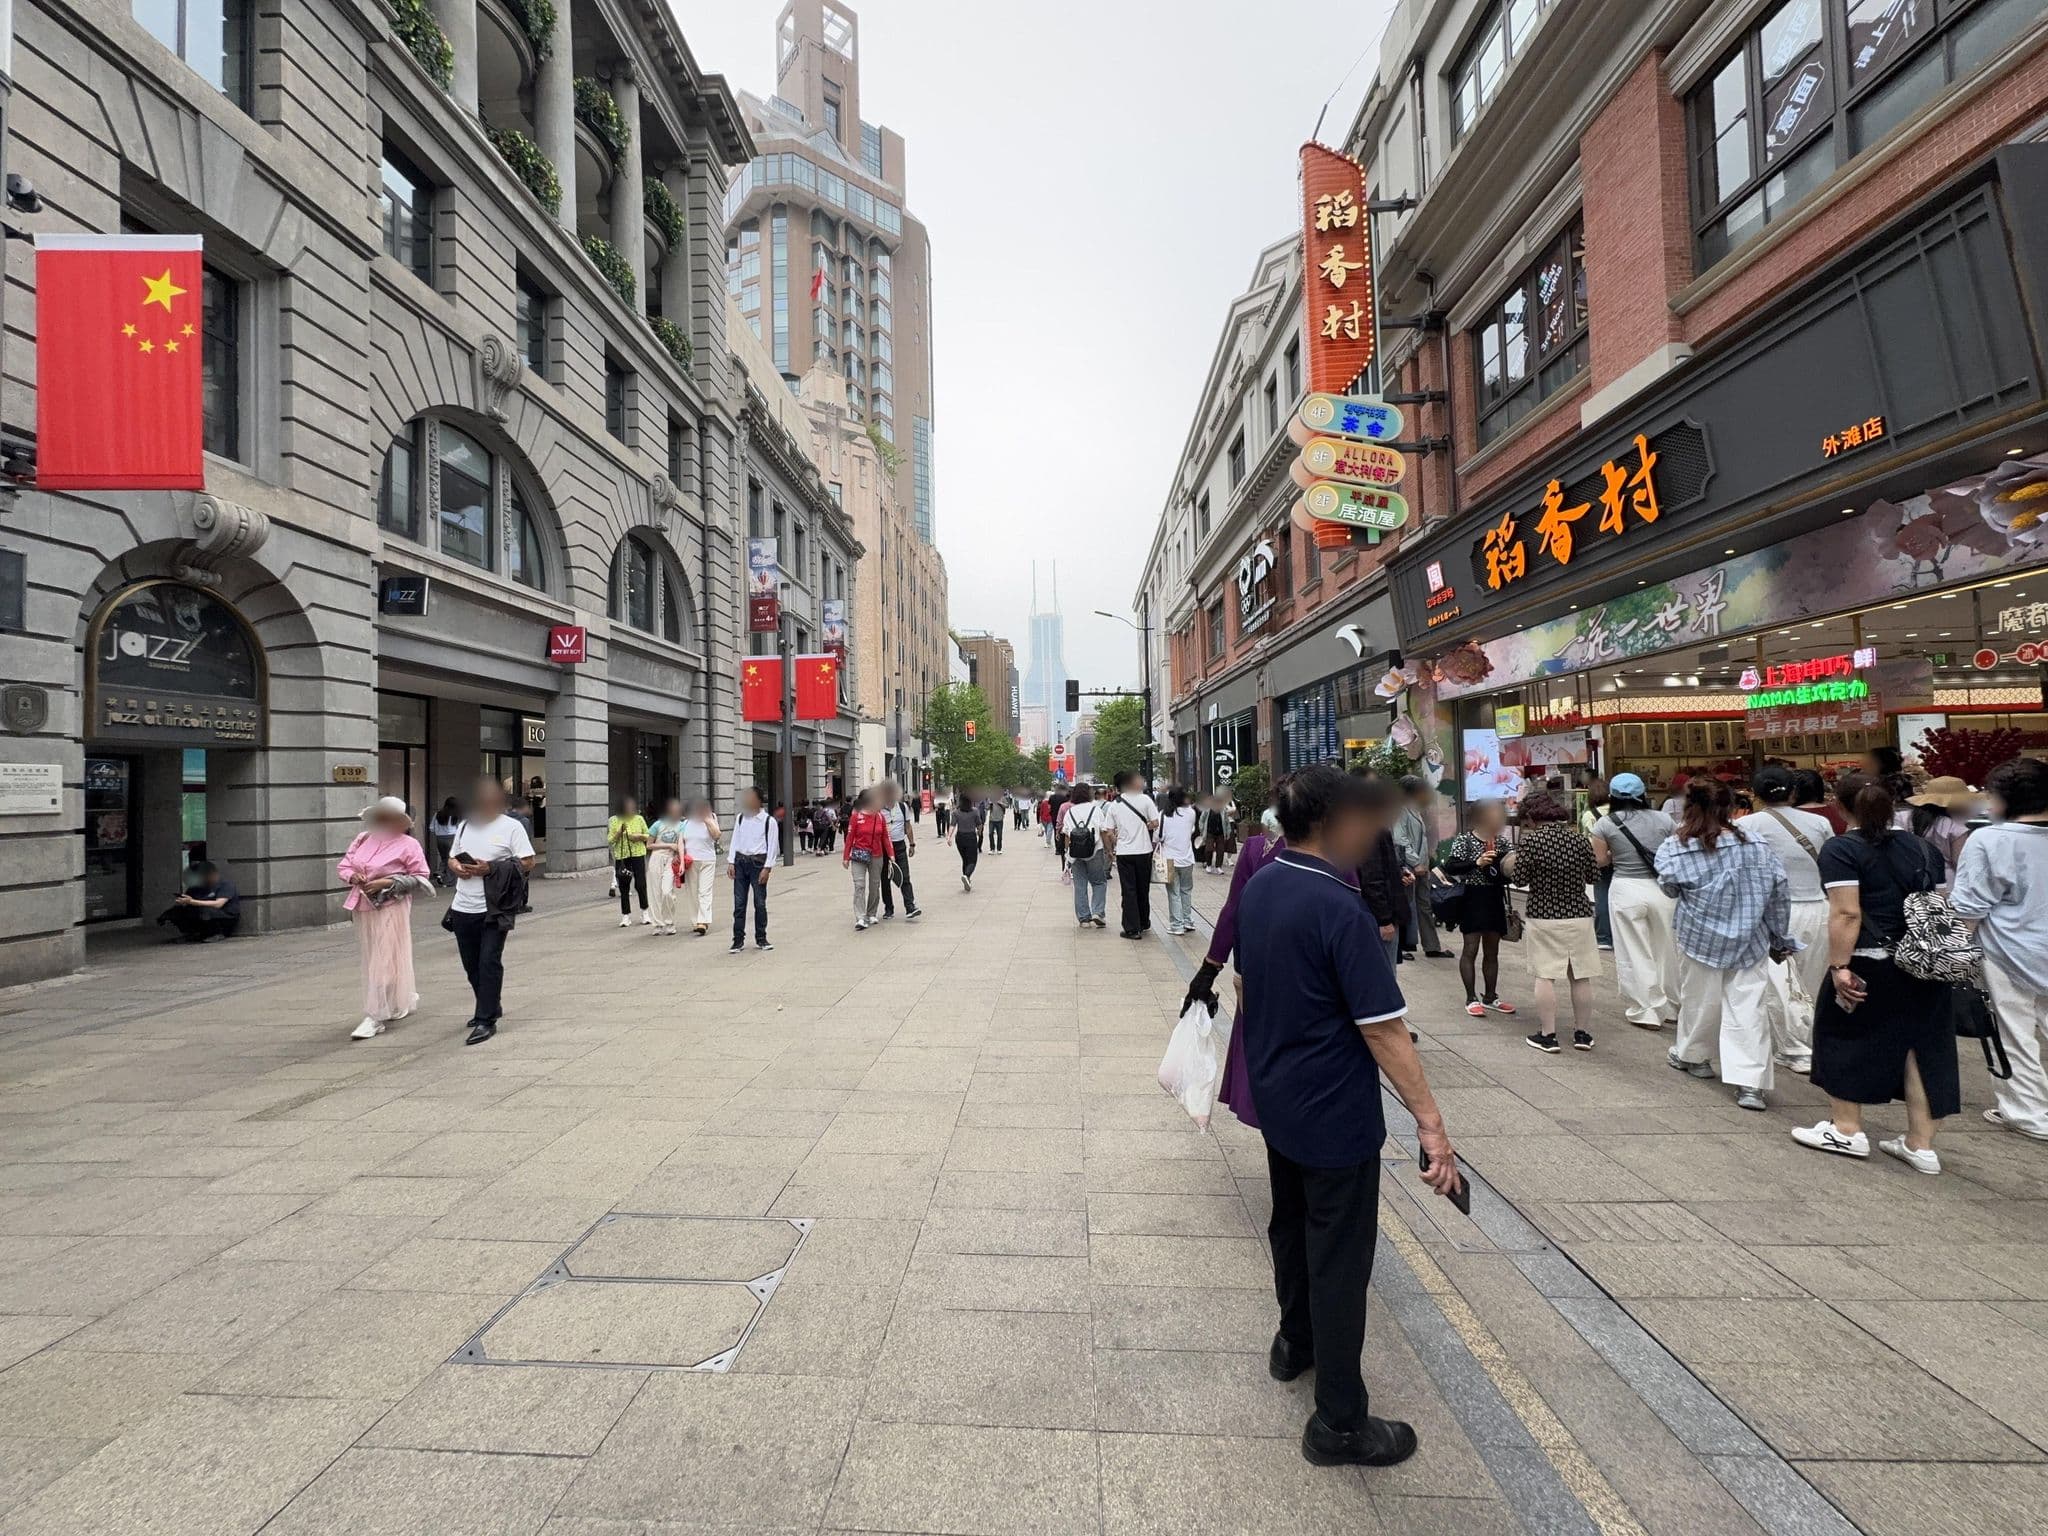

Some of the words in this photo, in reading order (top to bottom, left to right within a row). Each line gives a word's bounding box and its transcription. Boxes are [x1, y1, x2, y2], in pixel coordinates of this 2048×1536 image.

[1774, 72, 1818, 135] 意面
[1314, 189, 1364, 341] 稻香村
[1539, 263, 1557, 298] Italian
[1540, 330, 1552, 352] 3rd
[1550, 299, 1566, 331] Floor
[1312, 404, 1326, 418] 4F
[1822, 416, 1883, 458] 外滩店
[1313, 450, 1328, 463] 3F
[1343, 447, 1393, 466] ALLORA
[1334, 459, 1399, 483] 意大利餐厅
[1316, 494, 1331, 507] 2F
[1483, 433, 1660, 590] 稻香村
[1338, 503, 1396, 528] 居酒屋
[386, 589, 416, 603] jazz
[1553, 569, 1728, 664] 一花一世界
[105, 623, 190, 664] jazz
[1011, 686, 1019, 718] HUAWEI
[104, 710, 140, 726] jazz
[144, 713, 161, 726] at
[165, 713, 212, 728] lincoln
[215, 717, 257, 731] center
[341, 768, 362, 776] 139
